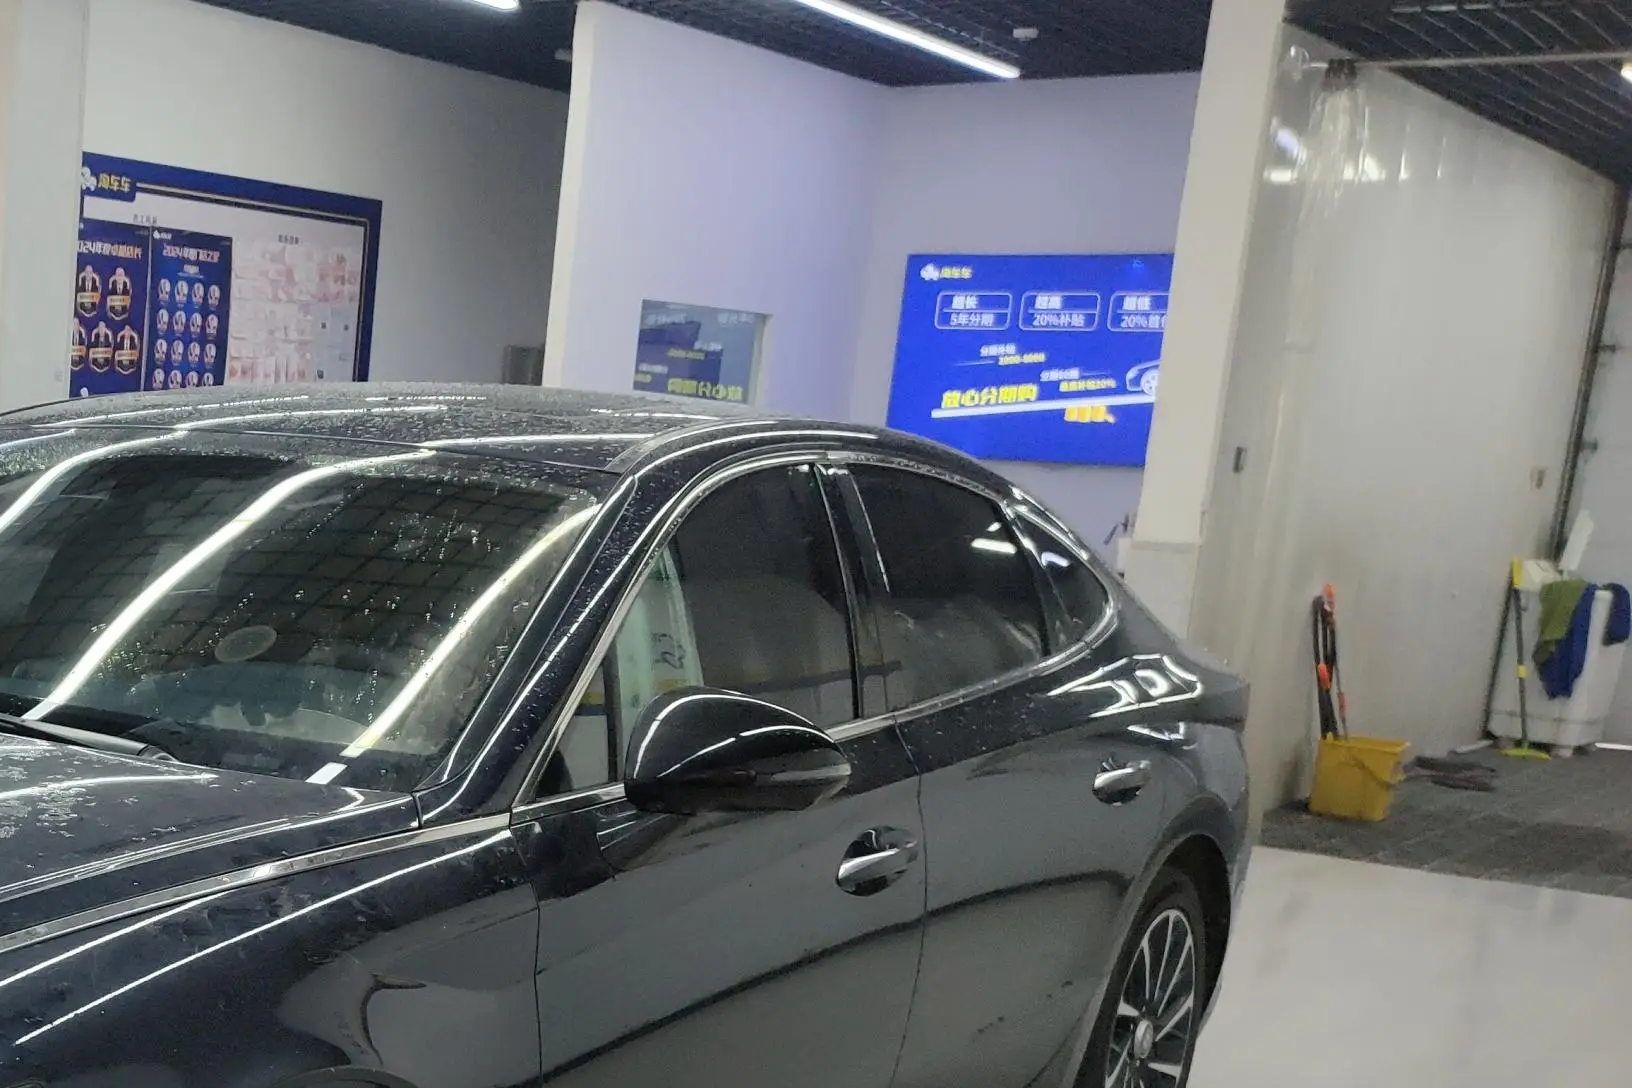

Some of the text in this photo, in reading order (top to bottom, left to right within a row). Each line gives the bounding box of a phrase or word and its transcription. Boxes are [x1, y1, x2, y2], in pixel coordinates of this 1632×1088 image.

[950, 312, 994, 327] 5年分期
[1032, 313, 1085, 327] 20%补贴
[941, 383, 1038, 409] 放心分期购
